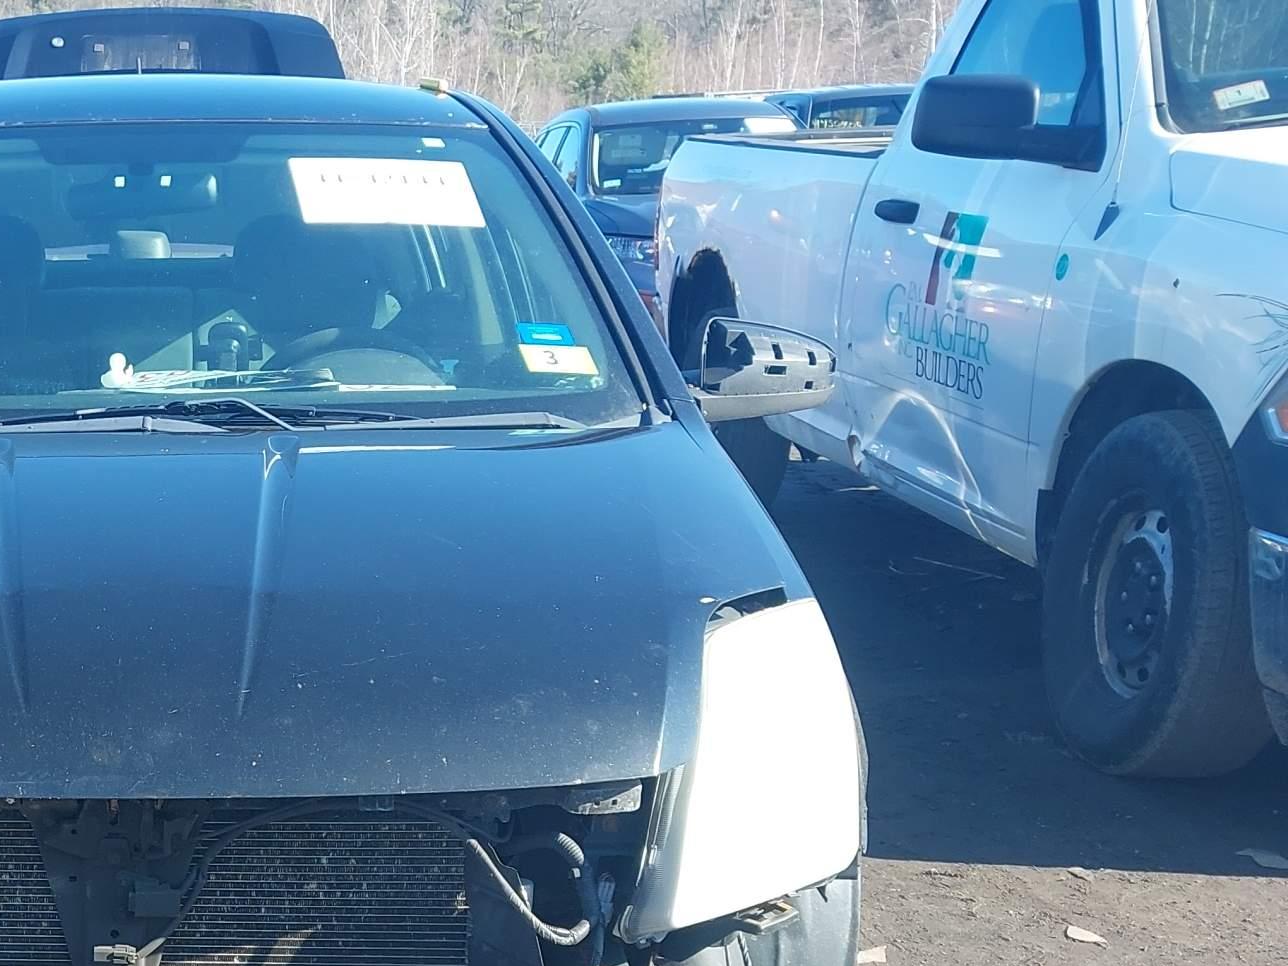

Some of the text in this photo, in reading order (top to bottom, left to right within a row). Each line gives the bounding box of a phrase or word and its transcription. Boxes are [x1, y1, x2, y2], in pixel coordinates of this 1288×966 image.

[886, 283, 991, 365] GALLAGHER
[543, 350, 559, 365] 3
[915, 346, 984, 399] BUILDERS
